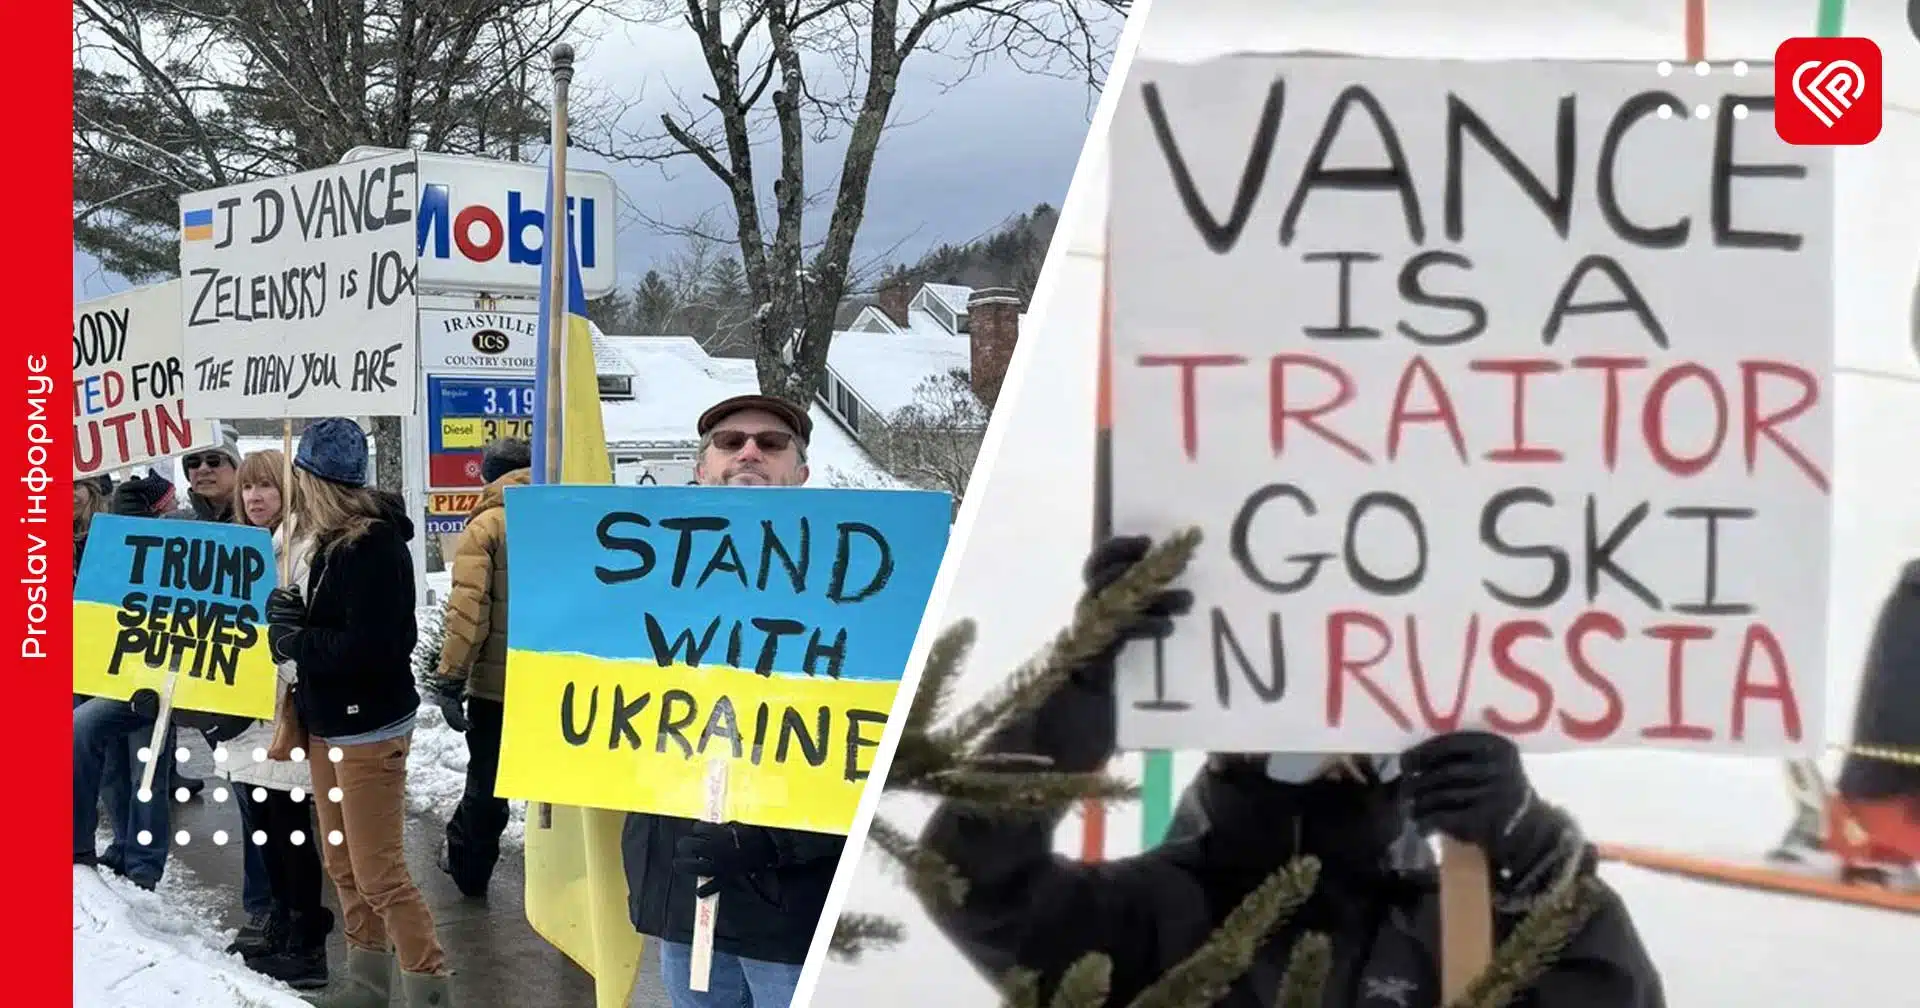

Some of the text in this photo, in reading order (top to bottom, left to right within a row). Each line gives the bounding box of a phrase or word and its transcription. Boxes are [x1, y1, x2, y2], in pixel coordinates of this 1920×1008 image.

[1140, 76, 1809, 254] VANCE
[214, 161, 417, 250] J D VANCE
[188, 261, 326, 328] ZELENSKY
[443, 313, 537, 337] IRASVILLE
[1302, 250, 1670, 349] IS A
[194, 342, 403, 400] THE MAN YOU ARE
[444, 355, 535, 368] COUNTRY STORE
[478, 334, 506, 350] ICS
[131, 356, 184, 402] FOR
[483, 386, 536, 415] 3.19
[443, 423, 474, 436] Diesel
[1136, 353, 1832, 494] TRAITOR
[125, 535, 265, 601] TRUMP
[594, 511, 896, 604] STAND
[1228, 482, 1757, 617] GO SKI
[116, 591, 260, 650] SERVES
[644, 612, 848, 680] WITH
[107, 627, 241, 686] PUTIN
[1132, 605, 1803, 743] IN RUSSIA
[560, 681, 890, 784] UKRAINE
